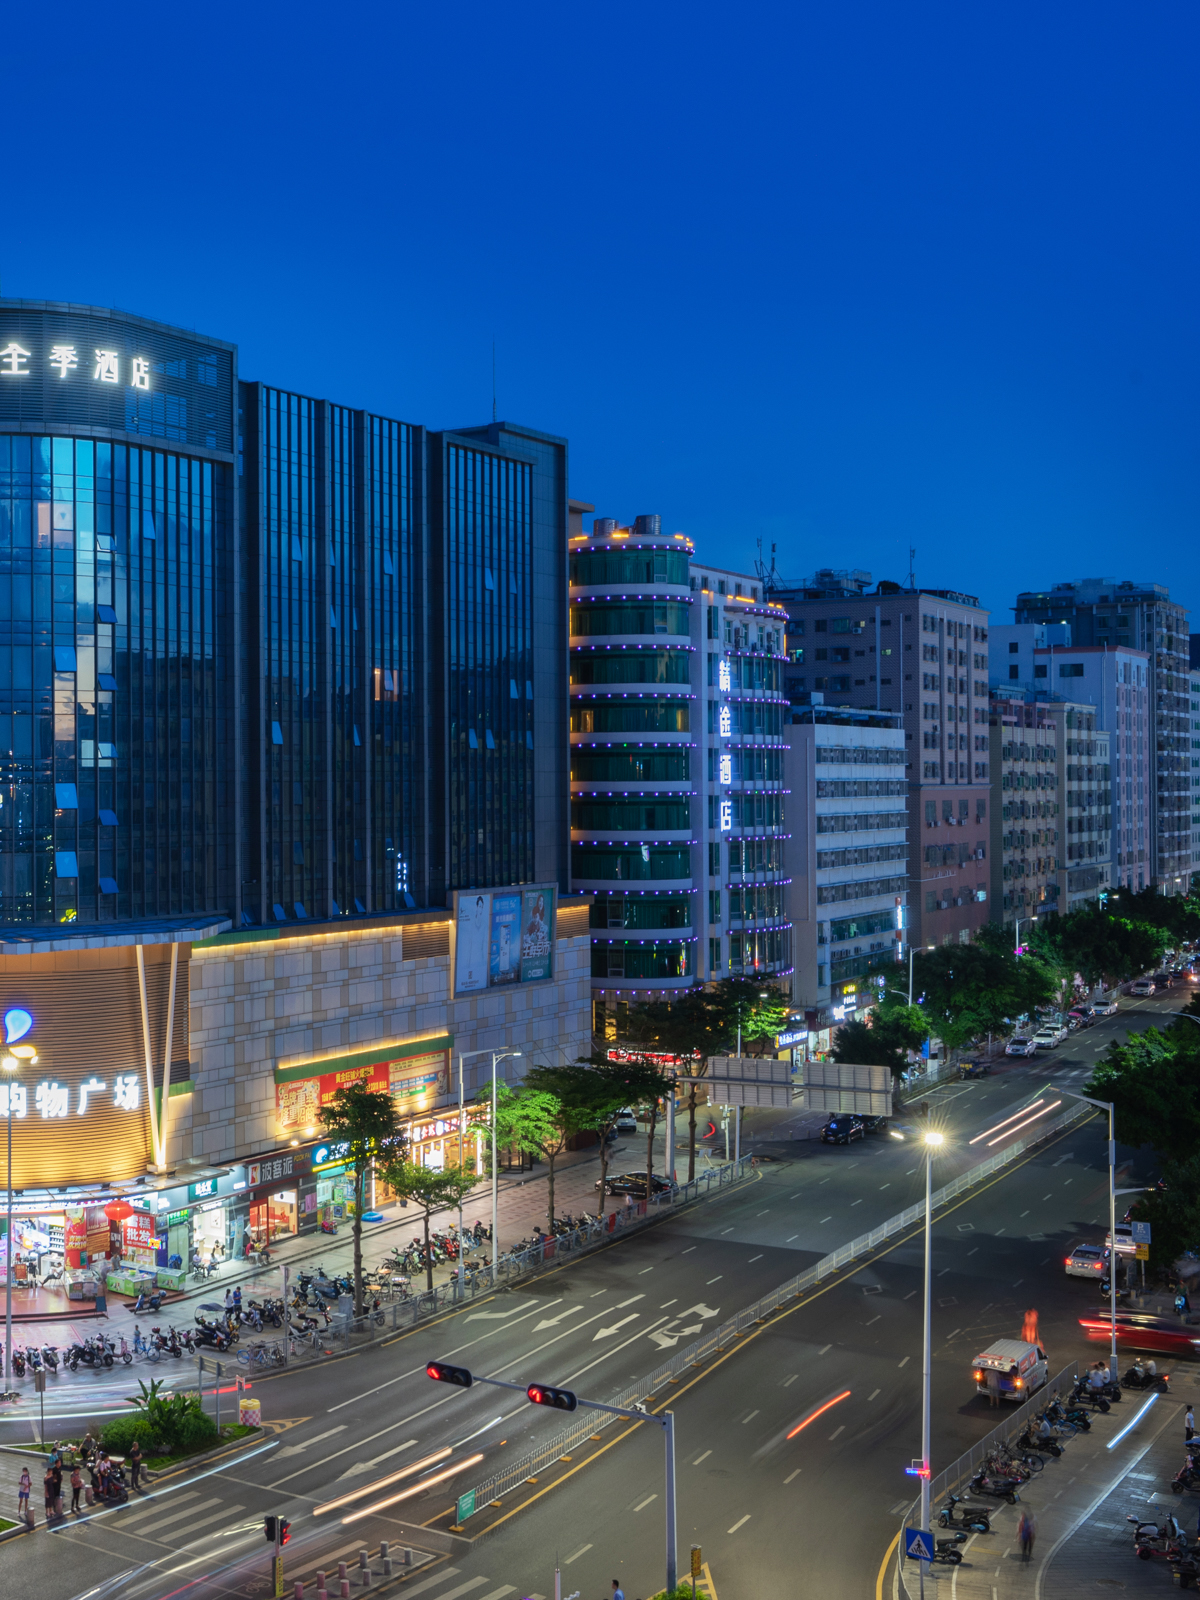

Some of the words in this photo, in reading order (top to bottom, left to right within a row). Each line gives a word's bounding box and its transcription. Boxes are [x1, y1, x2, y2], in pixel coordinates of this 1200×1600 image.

[262, 1156, 293, 1182] 波客派
[126, 1227, 151, 1242] 批发
